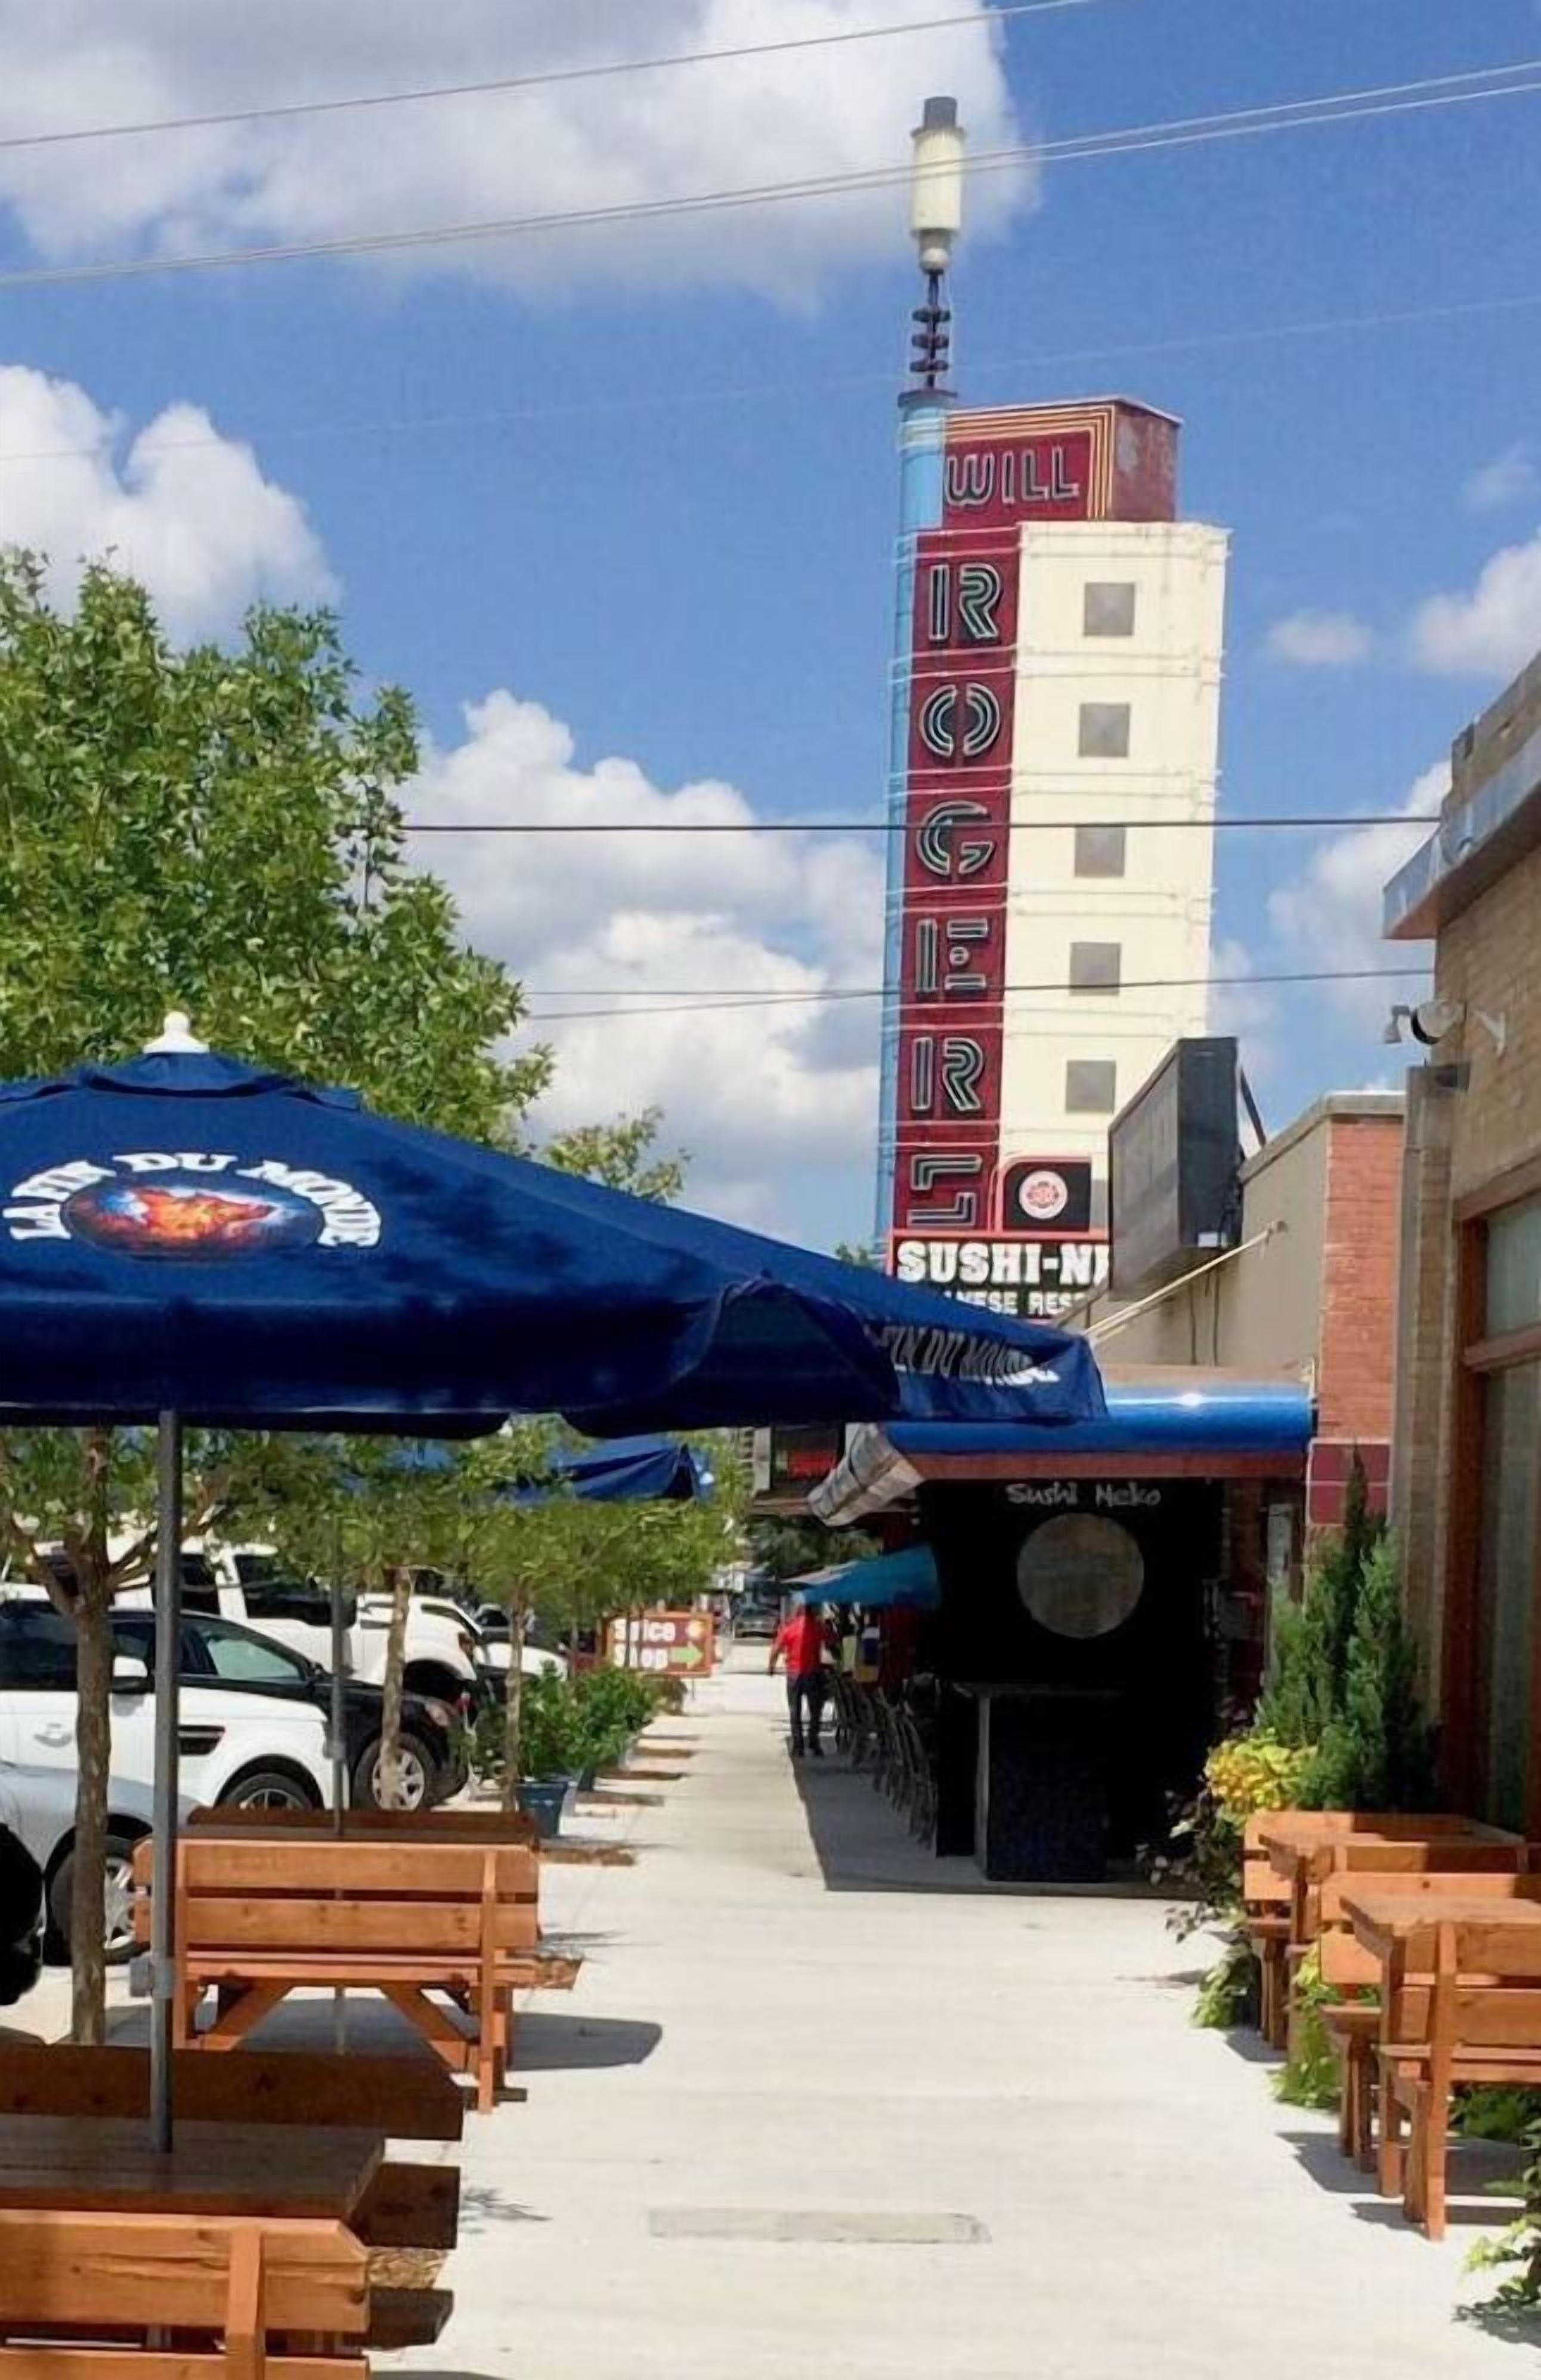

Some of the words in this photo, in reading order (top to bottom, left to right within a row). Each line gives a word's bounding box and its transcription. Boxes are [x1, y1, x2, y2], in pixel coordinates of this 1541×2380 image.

[944, 445, 1080, 506] WILL
[906, 563, 1001, 1228] ROGERS
[2, 1204, 72, 1240] LA
[112, 1152, 238, 1173] DU
[1005, 1480, 1078, 1506] Sushi
[1095, 1480, 1162, 1508] Neko
